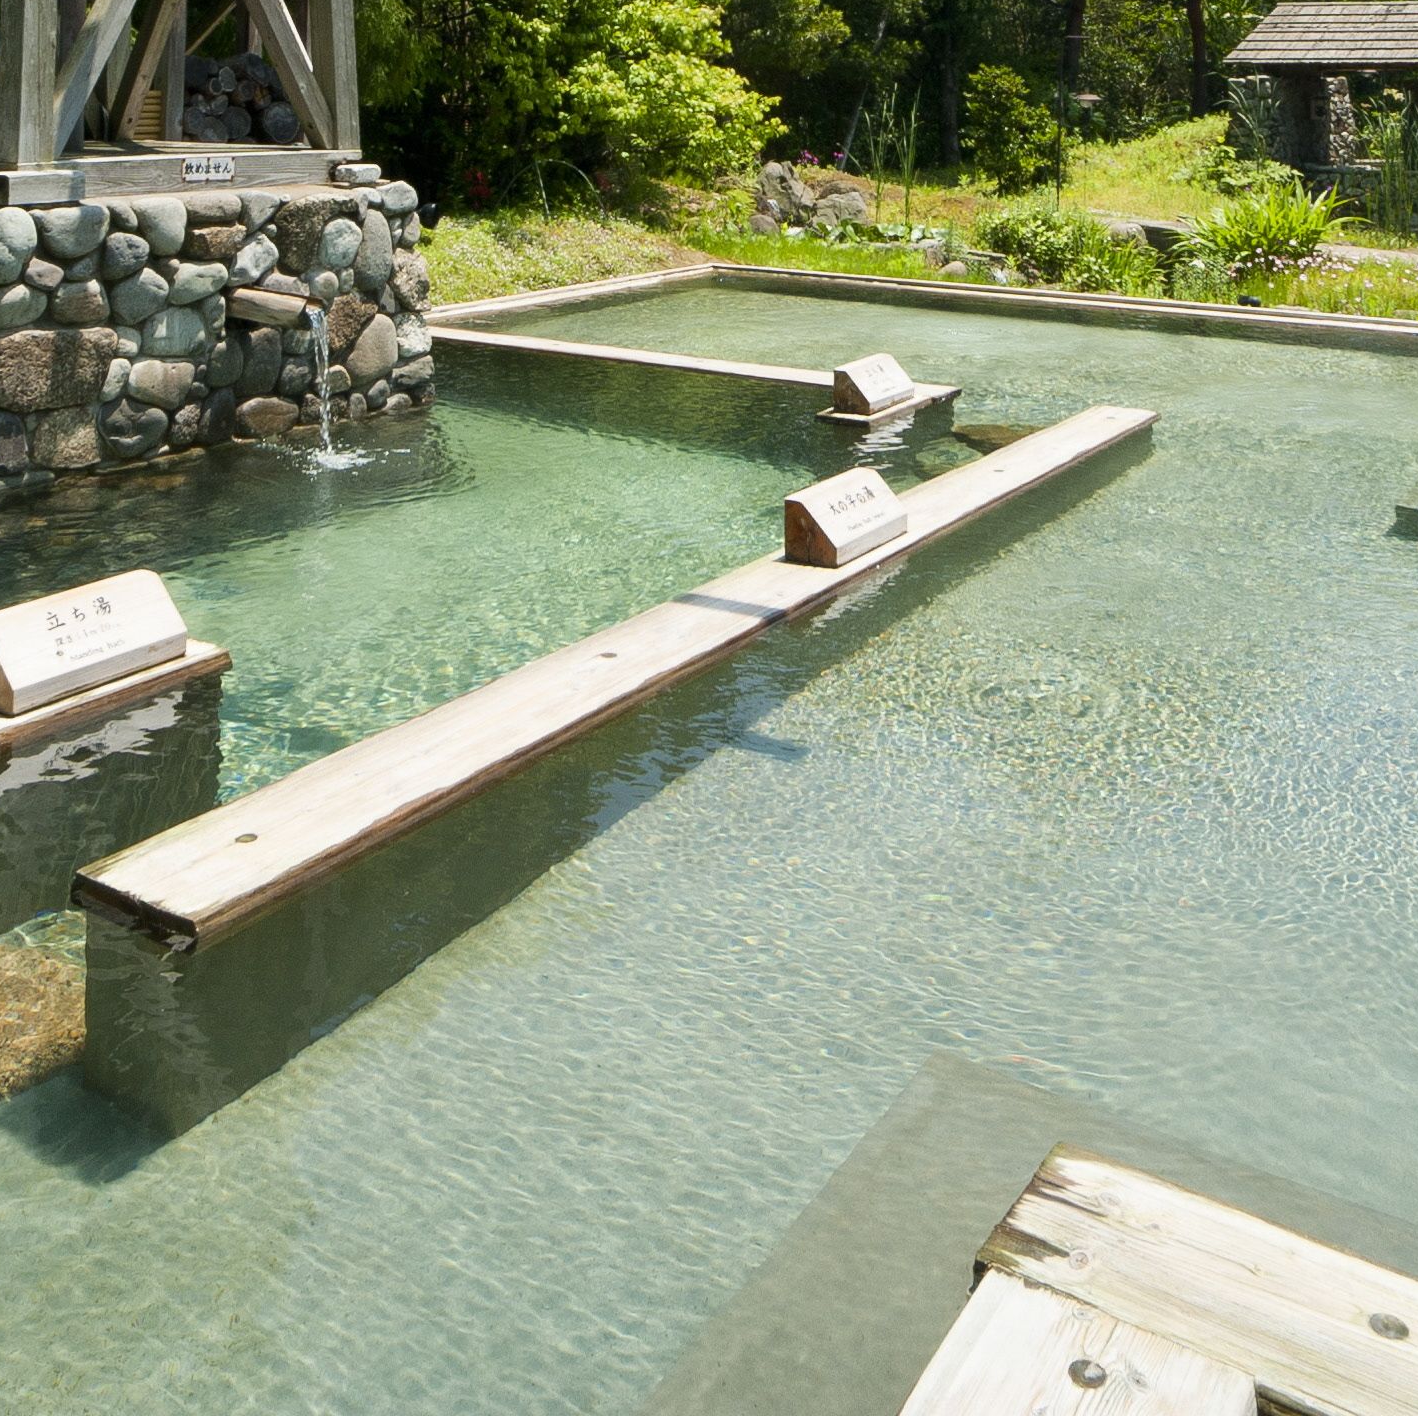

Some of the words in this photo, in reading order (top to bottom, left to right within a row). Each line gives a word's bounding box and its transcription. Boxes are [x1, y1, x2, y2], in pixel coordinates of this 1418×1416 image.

[184, 162, 232, 175] 飲めません
[46, 596, 112, 631] 立ち湯
